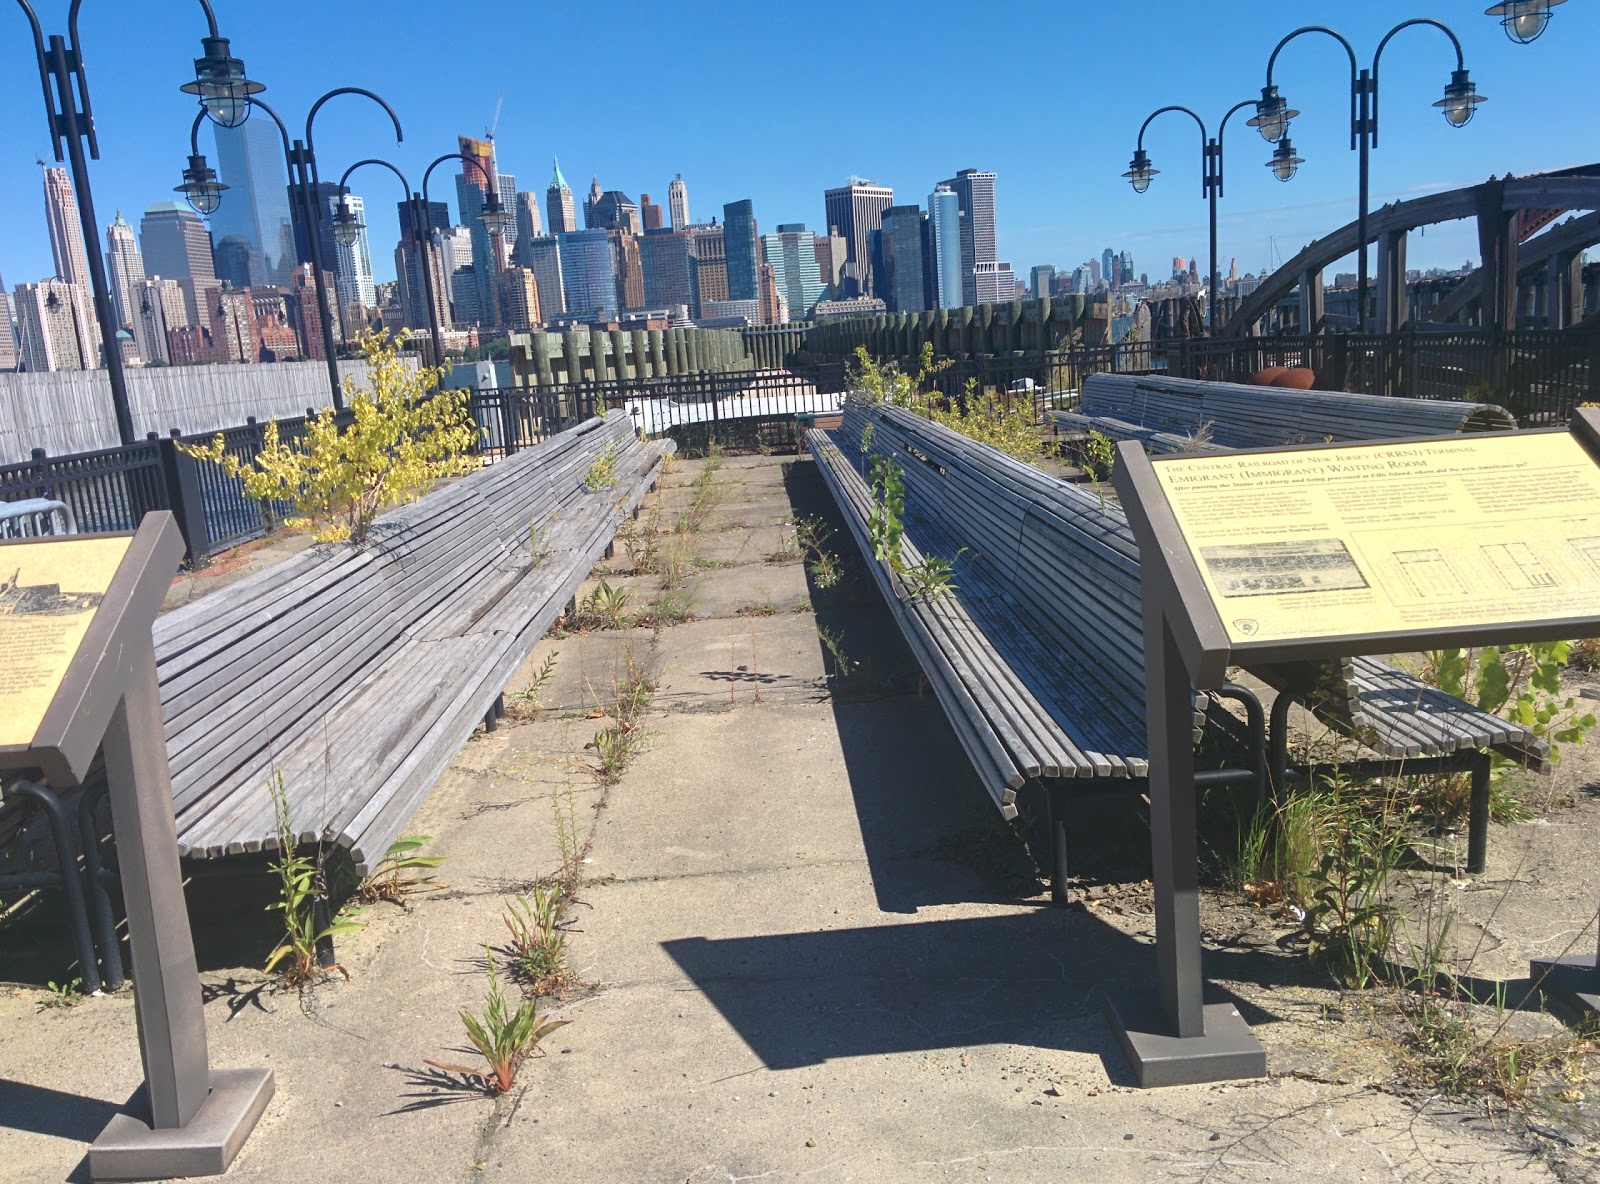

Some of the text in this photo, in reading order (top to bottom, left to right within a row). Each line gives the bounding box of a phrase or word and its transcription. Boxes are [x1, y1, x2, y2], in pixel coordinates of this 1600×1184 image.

[1237, 460, 1289, 468] RAILROAD
[1426, 446, 1477, 455] TERMINAL
[1168, 459, 1428, 484] EMIGRANT (IMMIGRANT) WAITING ROOM
